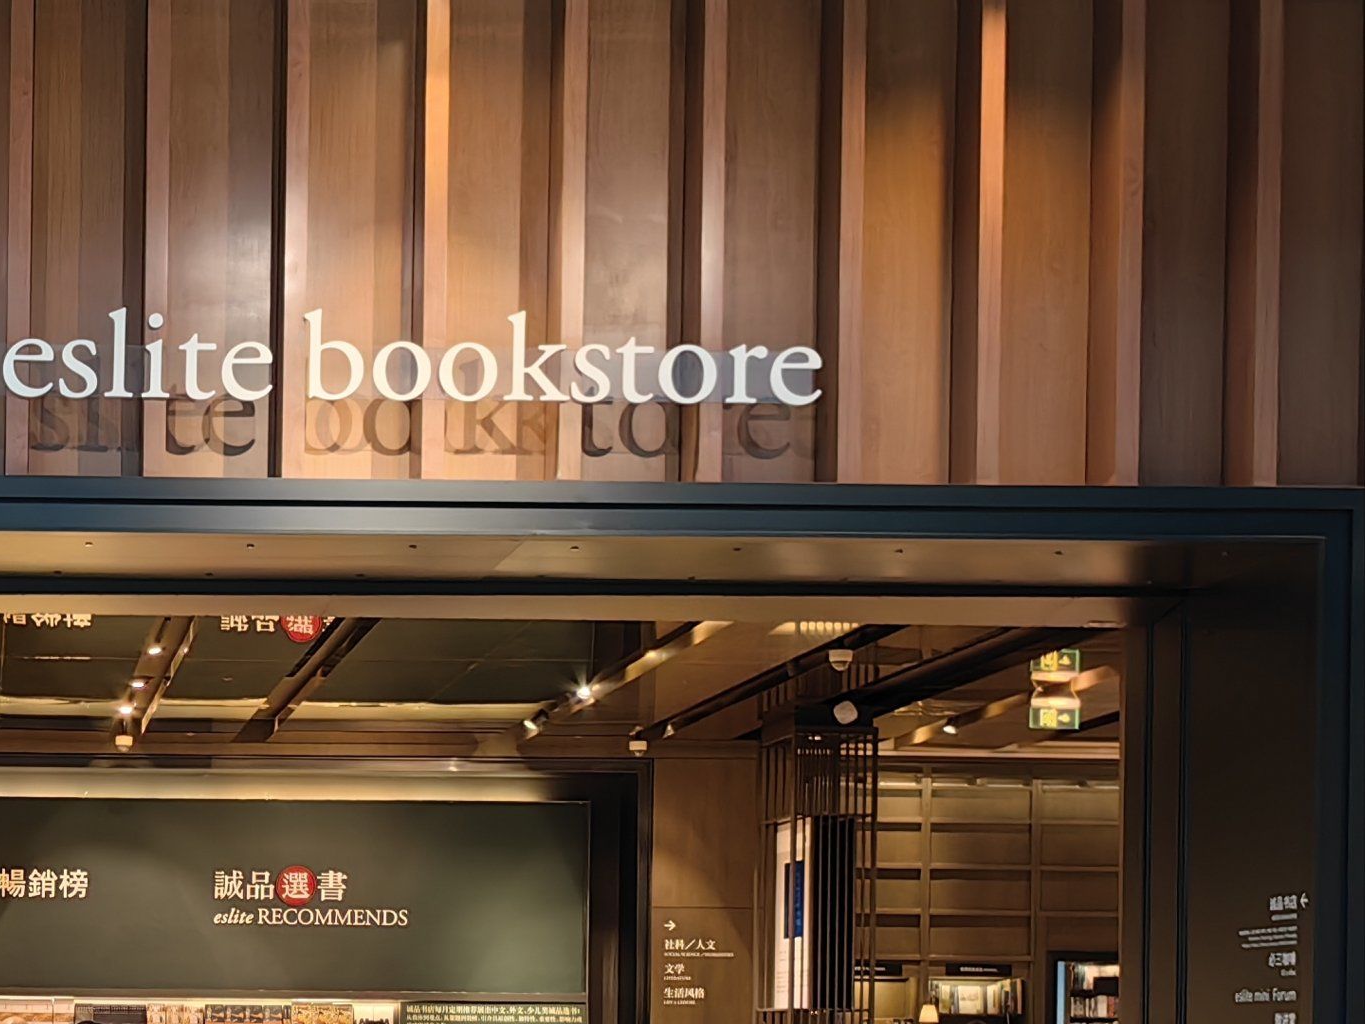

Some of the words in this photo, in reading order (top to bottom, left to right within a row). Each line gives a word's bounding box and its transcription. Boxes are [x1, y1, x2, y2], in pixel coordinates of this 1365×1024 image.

[2, 306, 274, 401] eslite
[303, 308, 824, 407] bookstore
[213, 907, 255, 925] eslite
[257, 907, 409, 926] RECOMMENDS
